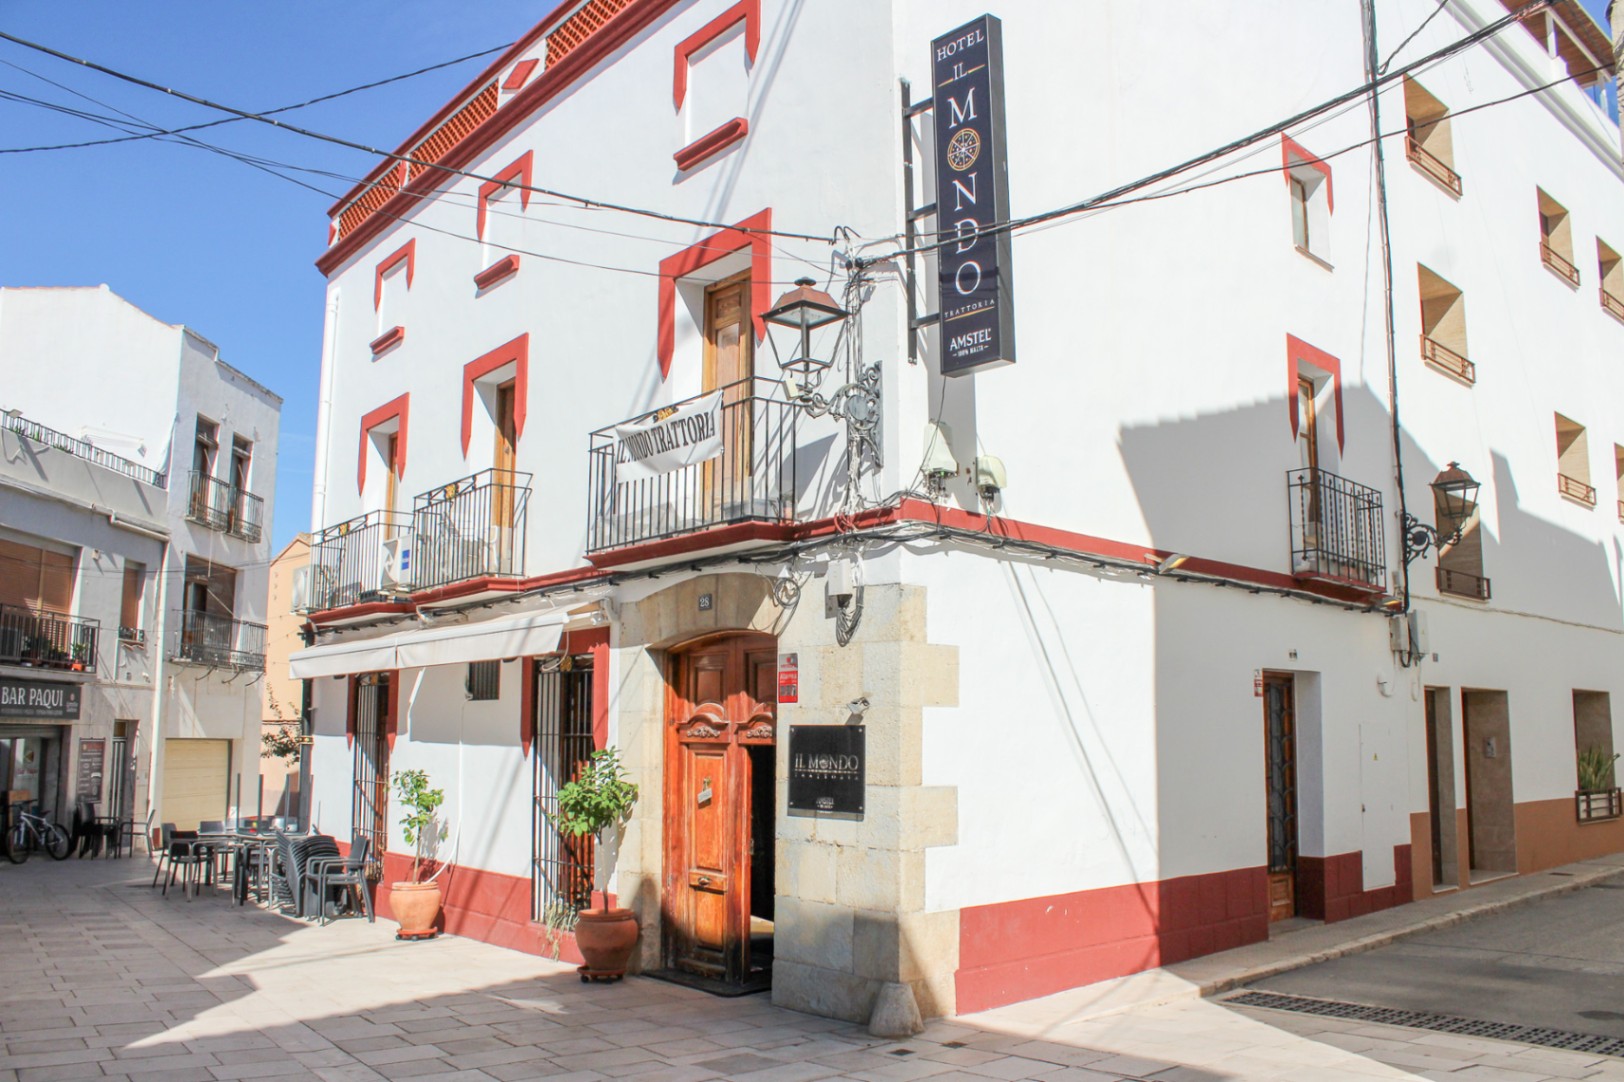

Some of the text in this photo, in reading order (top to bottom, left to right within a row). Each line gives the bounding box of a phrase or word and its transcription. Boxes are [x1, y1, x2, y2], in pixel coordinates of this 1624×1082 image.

[937, 29, 984, 62] HOTEL
[953, 62, 967, 80] IL
[944, 299, 995, 318] TRATTORIA
[949, 328, 992, 352] AMSTEL
[651, 411, 716, 454] TRATTORIA
[699, 597, 710, 607] 28
[1, 686, 26, 705] BAR
[29, 688, 64, 709] PAQUI
[795, 753, 806, 769] IL
